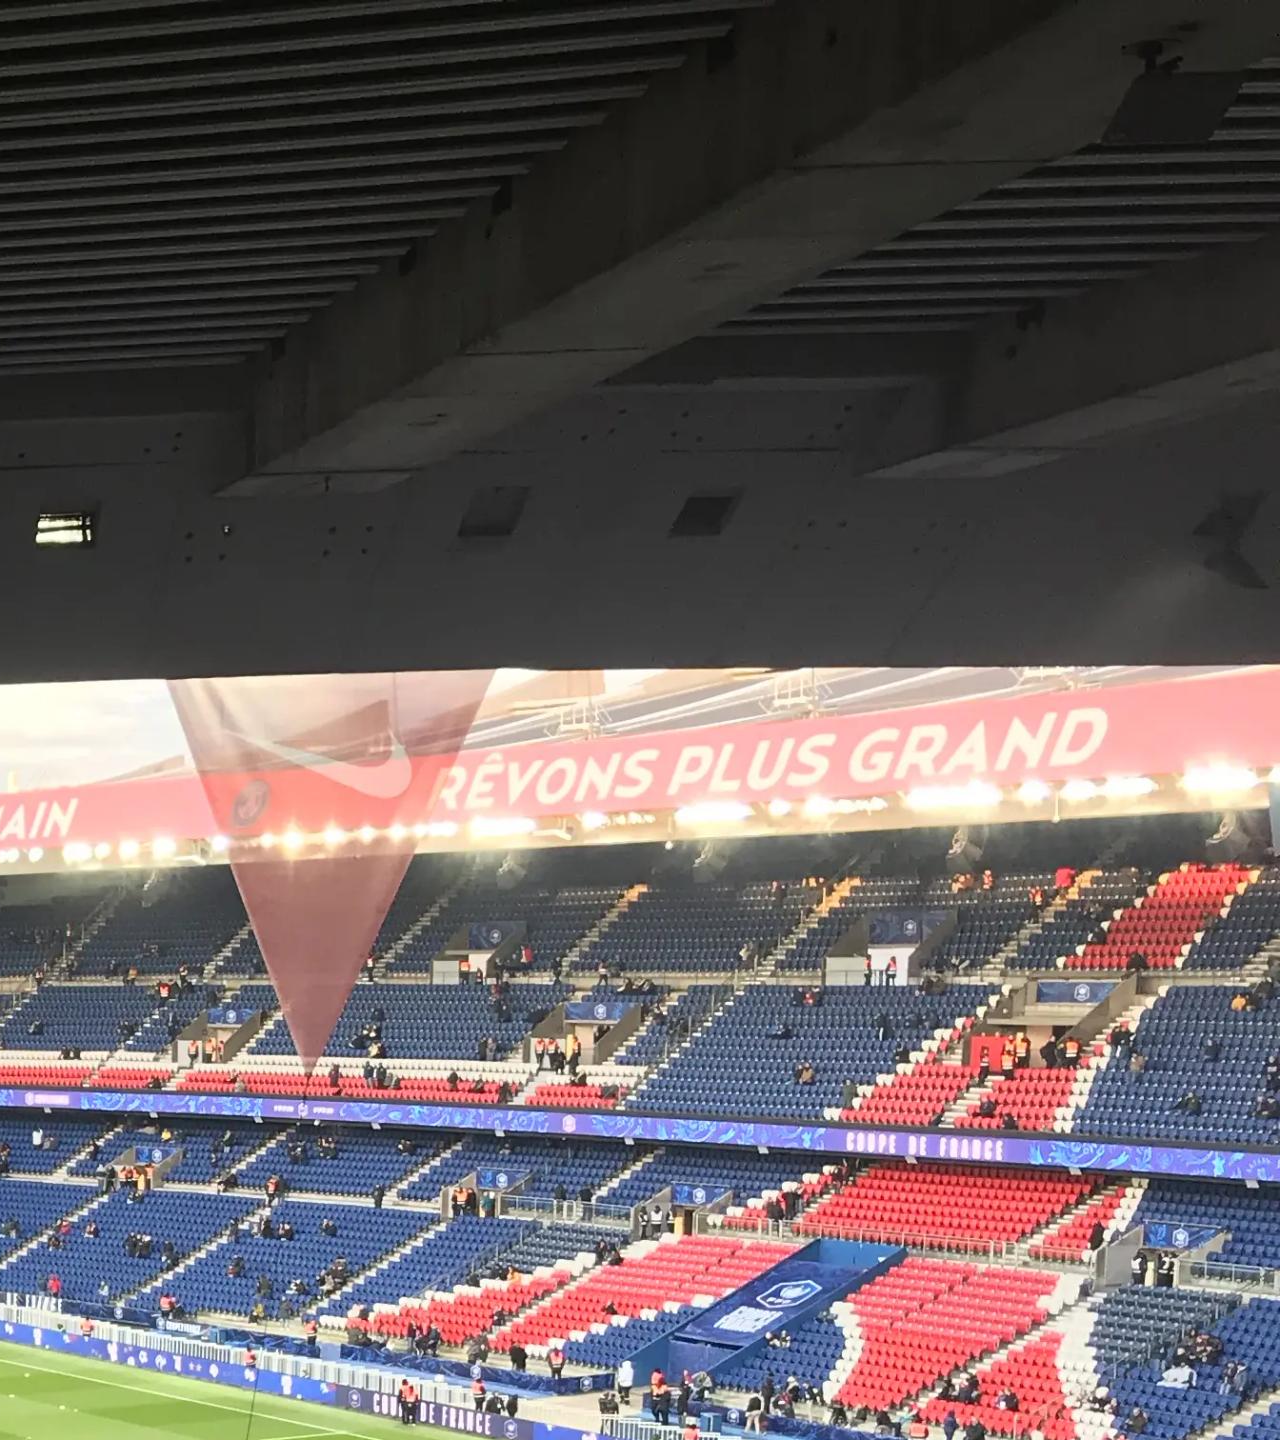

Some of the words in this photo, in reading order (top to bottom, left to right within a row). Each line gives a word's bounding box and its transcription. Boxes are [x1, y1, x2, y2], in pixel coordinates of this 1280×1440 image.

[428, 751, 660, 811] RÊVONS
[668, 733, 836, 796] PLUS
[847, 706, 1109, 782] GRAND
[846, 1131, 896, 1154] COUPE
[908, 1135, 927, 1156] DE
[940, 1137, 1003, 1161] FRANCE
[420, 1401, 435, 1424] DE
[441, 1405, 491, 1436] FRANCE
